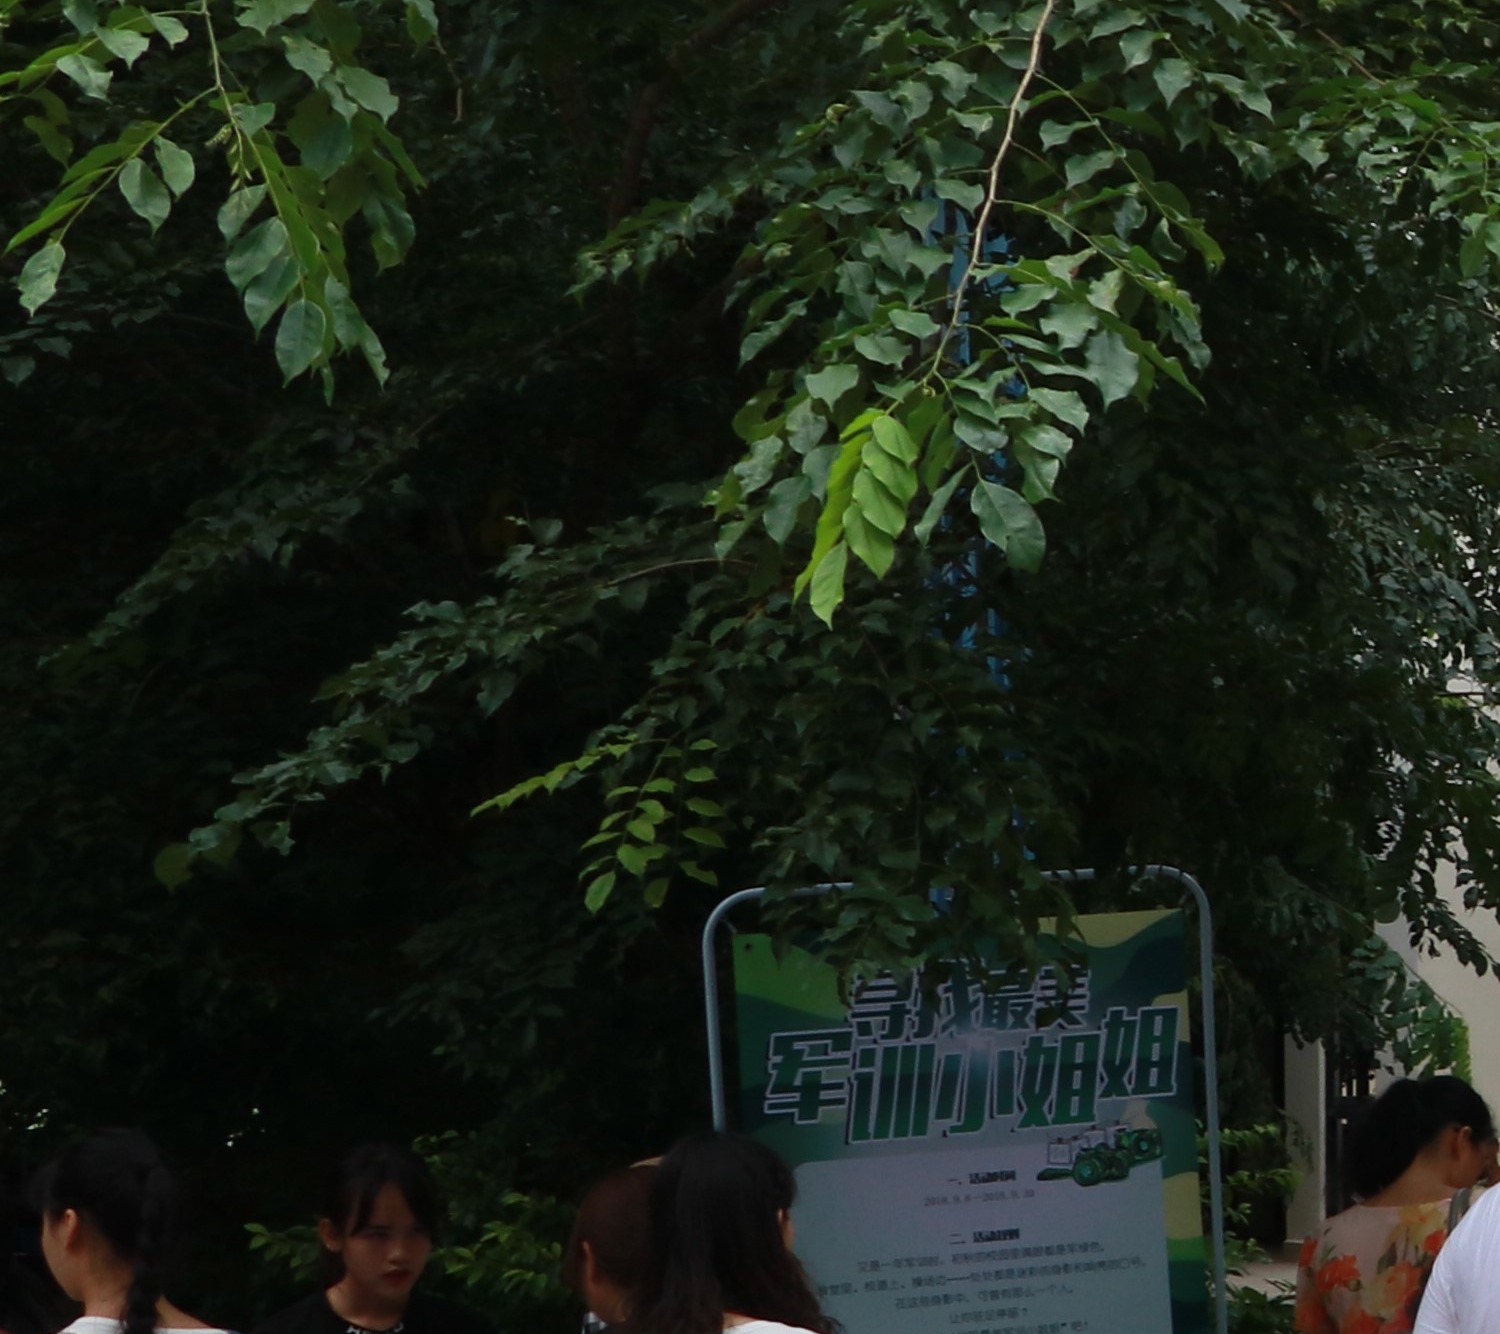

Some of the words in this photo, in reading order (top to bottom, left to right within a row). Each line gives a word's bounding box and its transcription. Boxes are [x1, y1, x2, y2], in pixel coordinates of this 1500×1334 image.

[764, 1005, 1180, 1145] 军训小姐姐
